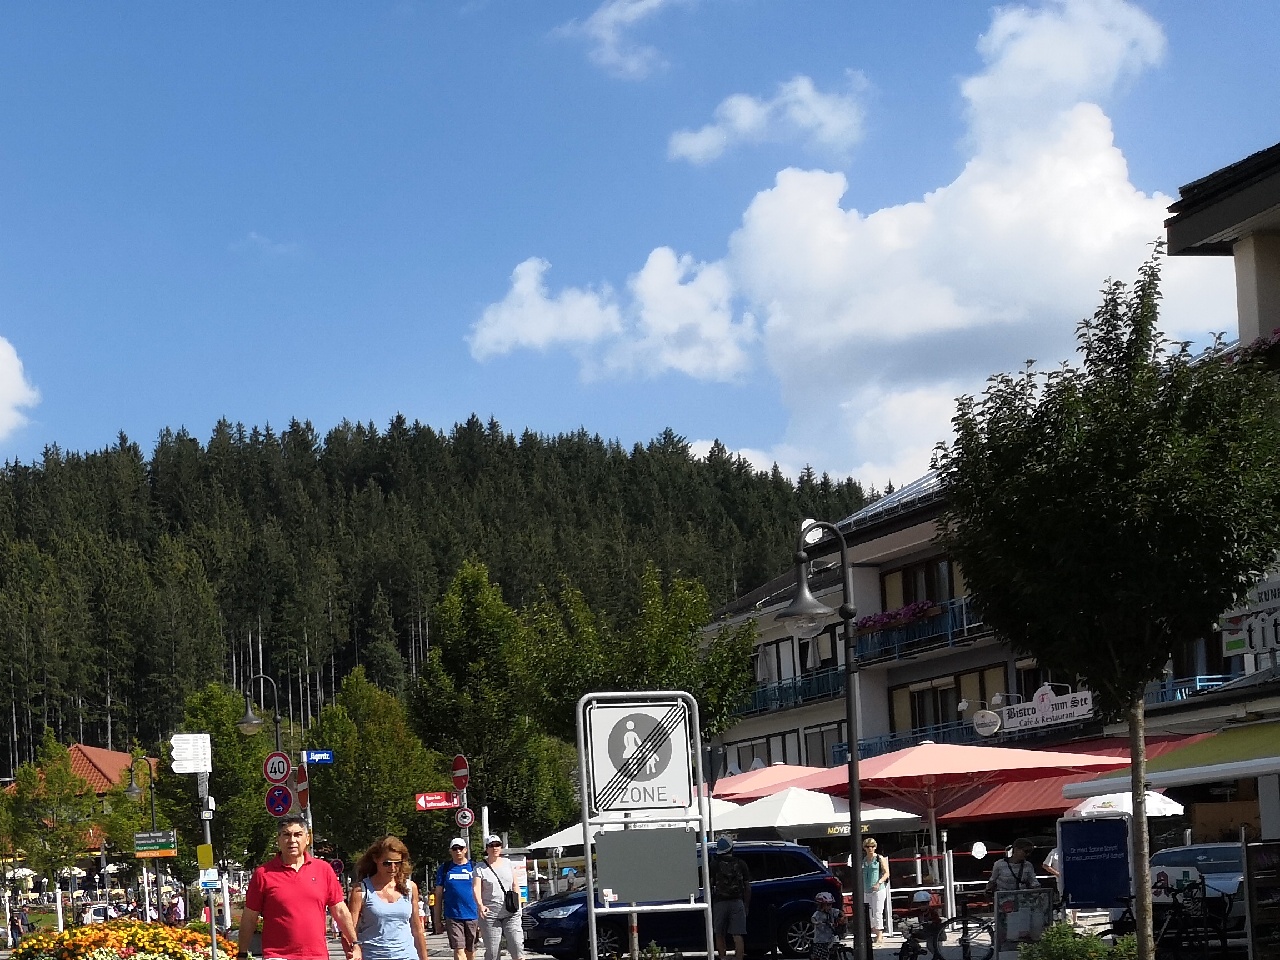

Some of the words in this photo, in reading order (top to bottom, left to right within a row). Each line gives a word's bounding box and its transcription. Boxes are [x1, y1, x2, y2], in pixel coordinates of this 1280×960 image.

[1007, 706, 1036, 720] Bistro
[1051, 701, 1068, 712] zum
[1070, 697, 1089, 708] See
[1019, 717, 1033, 726] Café
[1042, 711, 1075, 724] Restaurant
[270, 760, 285, 775] 40
[620, 786, 668, 804] ZONE
